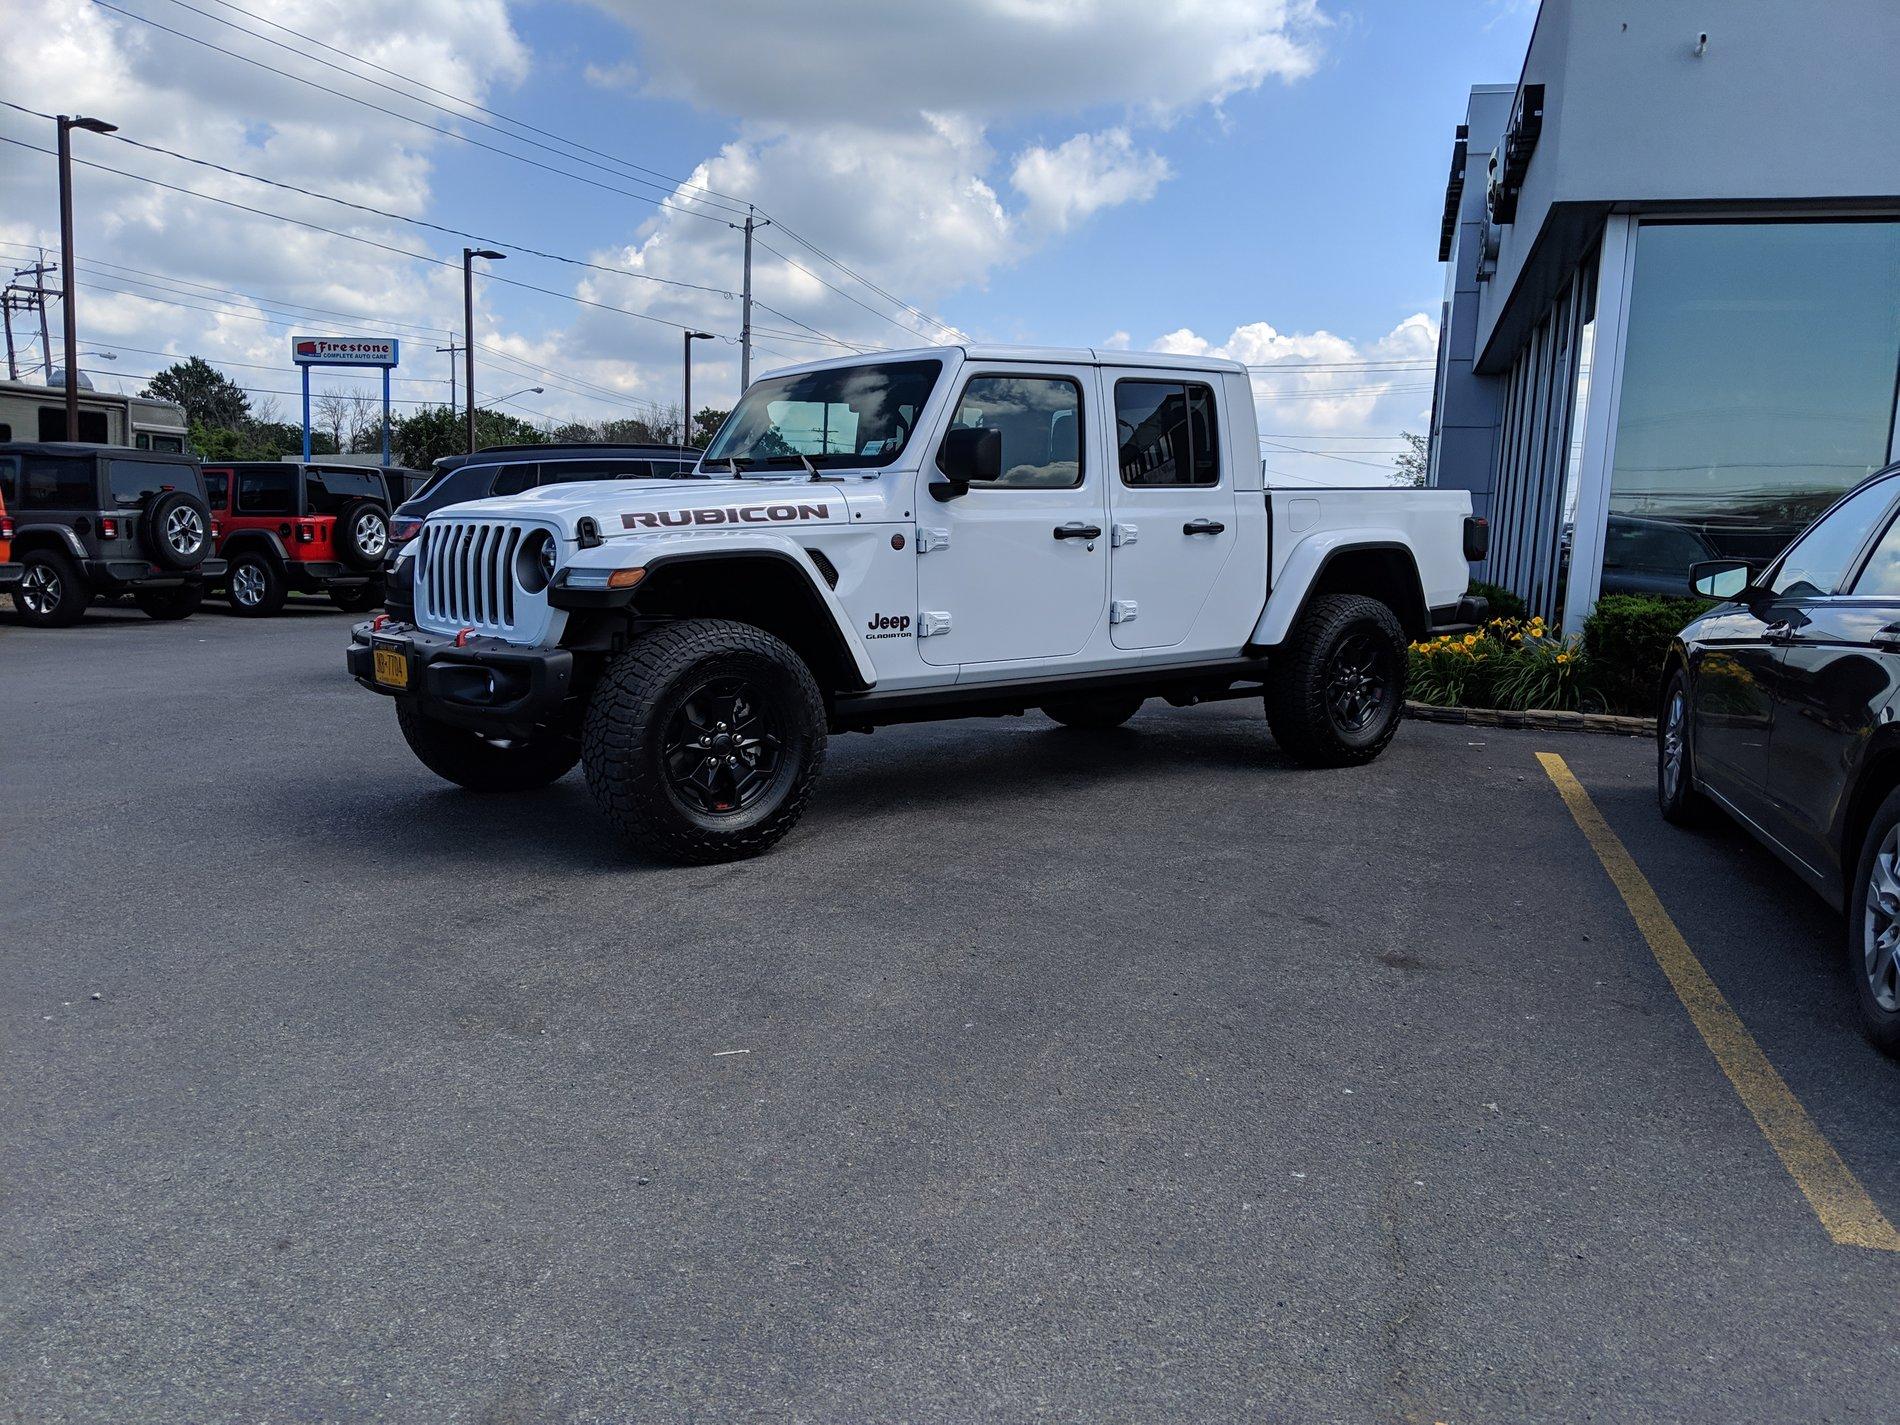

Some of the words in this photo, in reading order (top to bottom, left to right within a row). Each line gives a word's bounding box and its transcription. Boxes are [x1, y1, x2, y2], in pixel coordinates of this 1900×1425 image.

[319, 342, 389, 353] Firestone
[620, 504, 829, 529] RUBICON
[868, 612, 910, 631] Jeep
